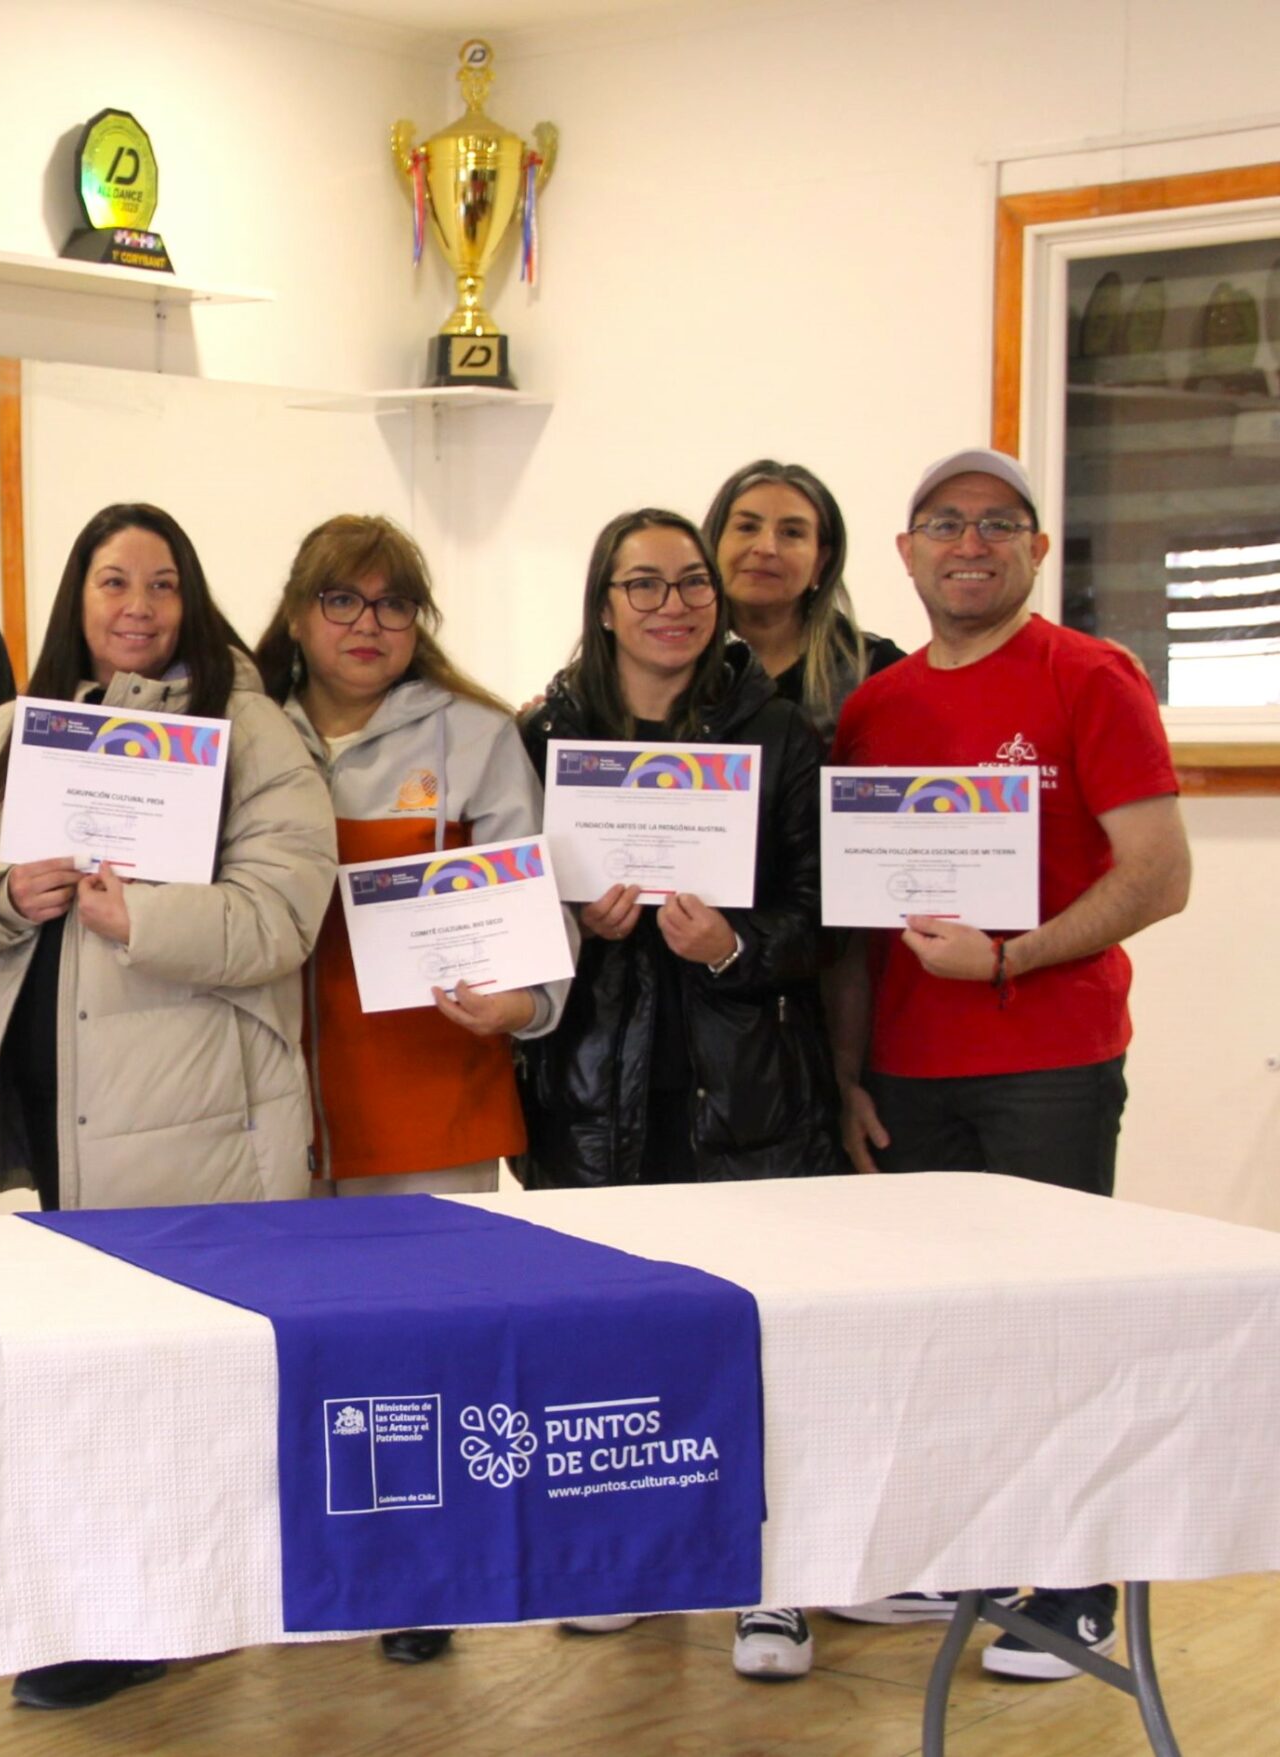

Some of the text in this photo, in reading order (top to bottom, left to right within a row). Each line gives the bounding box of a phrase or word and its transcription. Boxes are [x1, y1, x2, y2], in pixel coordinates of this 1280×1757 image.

[112, 187, 143, 203] DANCE
[120, 251, 166, 268] CORYBANT
[111, 793, 144, 803] CULTURAL
[575, 820, 614, 829] FUNDACIÓN
[616, 822, 636, 830] ARTES
[637, 823, 647, 831] DE
[648, 823, 657, 831] LA
[969, 848, 980, 856] DE
[375, 1402, 432, 1412] Ministerio de
[375, 1413, 428, 1422] las Culturas,
[375, 1421, 429, 1434] las Artes y el
[545, 1410, 661, 1444] PUNTOS
[375, 1432, 423, 1443] Patrimonio
[546, 1436, 719, 1477] DE CULTURA
[548, 1468, 719, 1499] www.puntos.cultura.gob.cl
[378, 1493, 436, 1504] Gobierno de Chile
